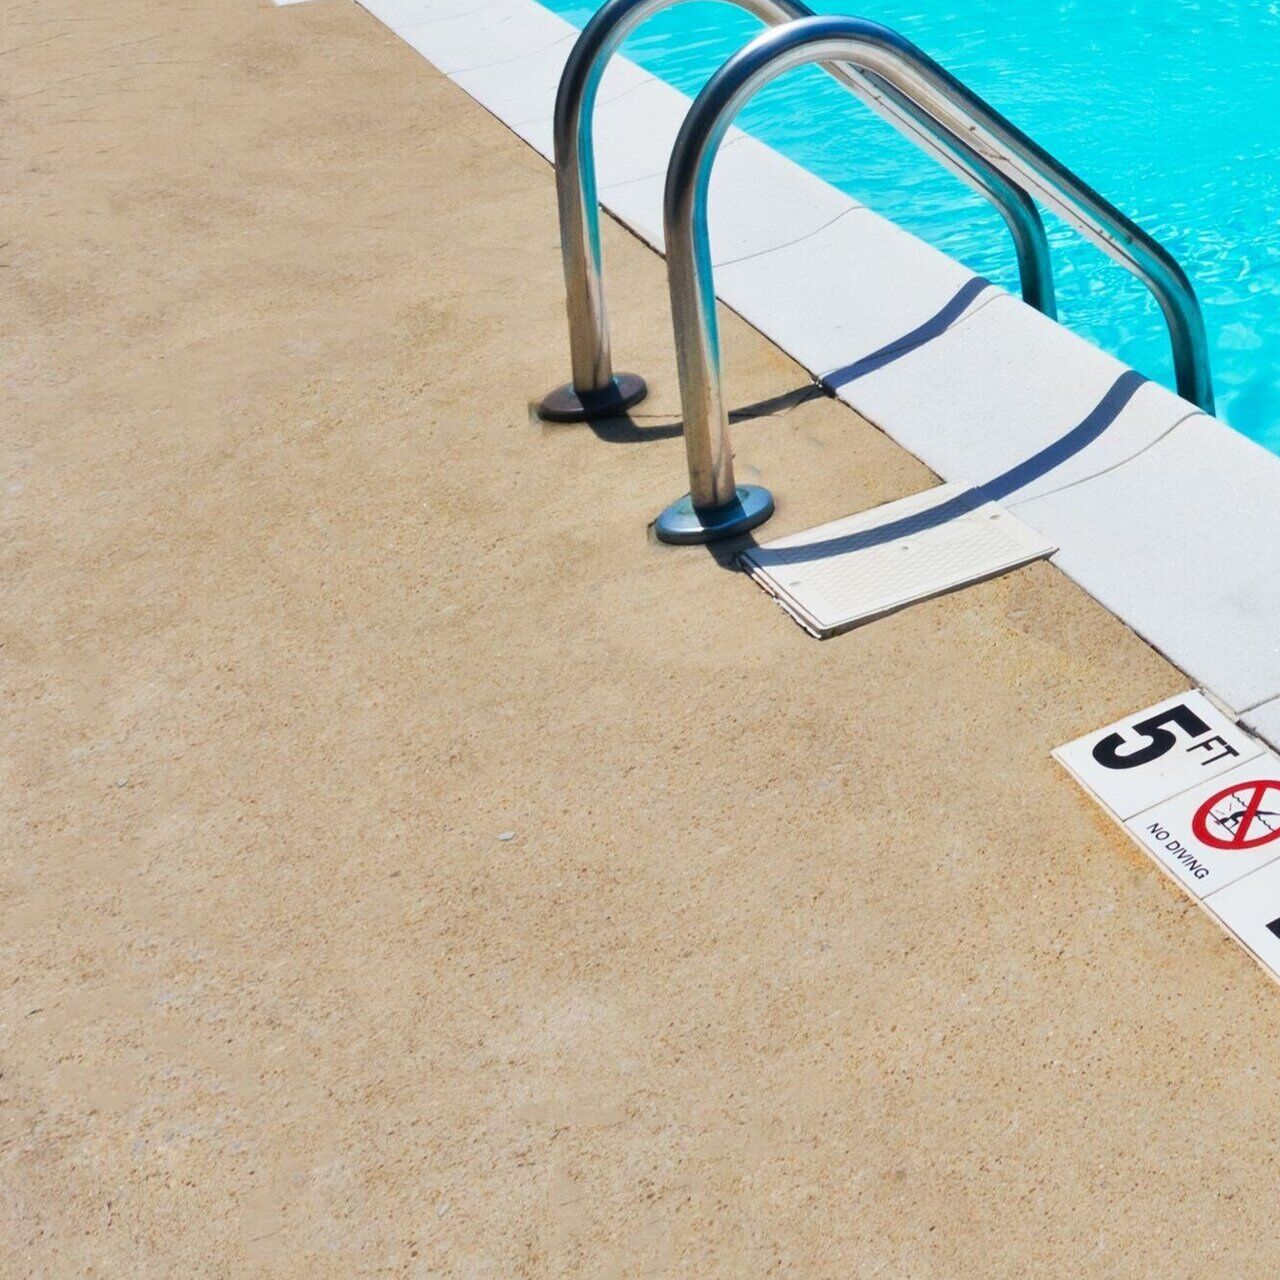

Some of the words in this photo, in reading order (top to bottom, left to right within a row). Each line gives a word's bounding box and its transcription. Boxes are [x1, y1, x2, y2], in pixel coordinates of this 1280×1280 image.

[1092, 703, 1212, 770] 5
[1186, 734, 1240, 767] FT
[1146, 822, 1170, 841] NO
[1165, 840, 1210, 880] DIVING
